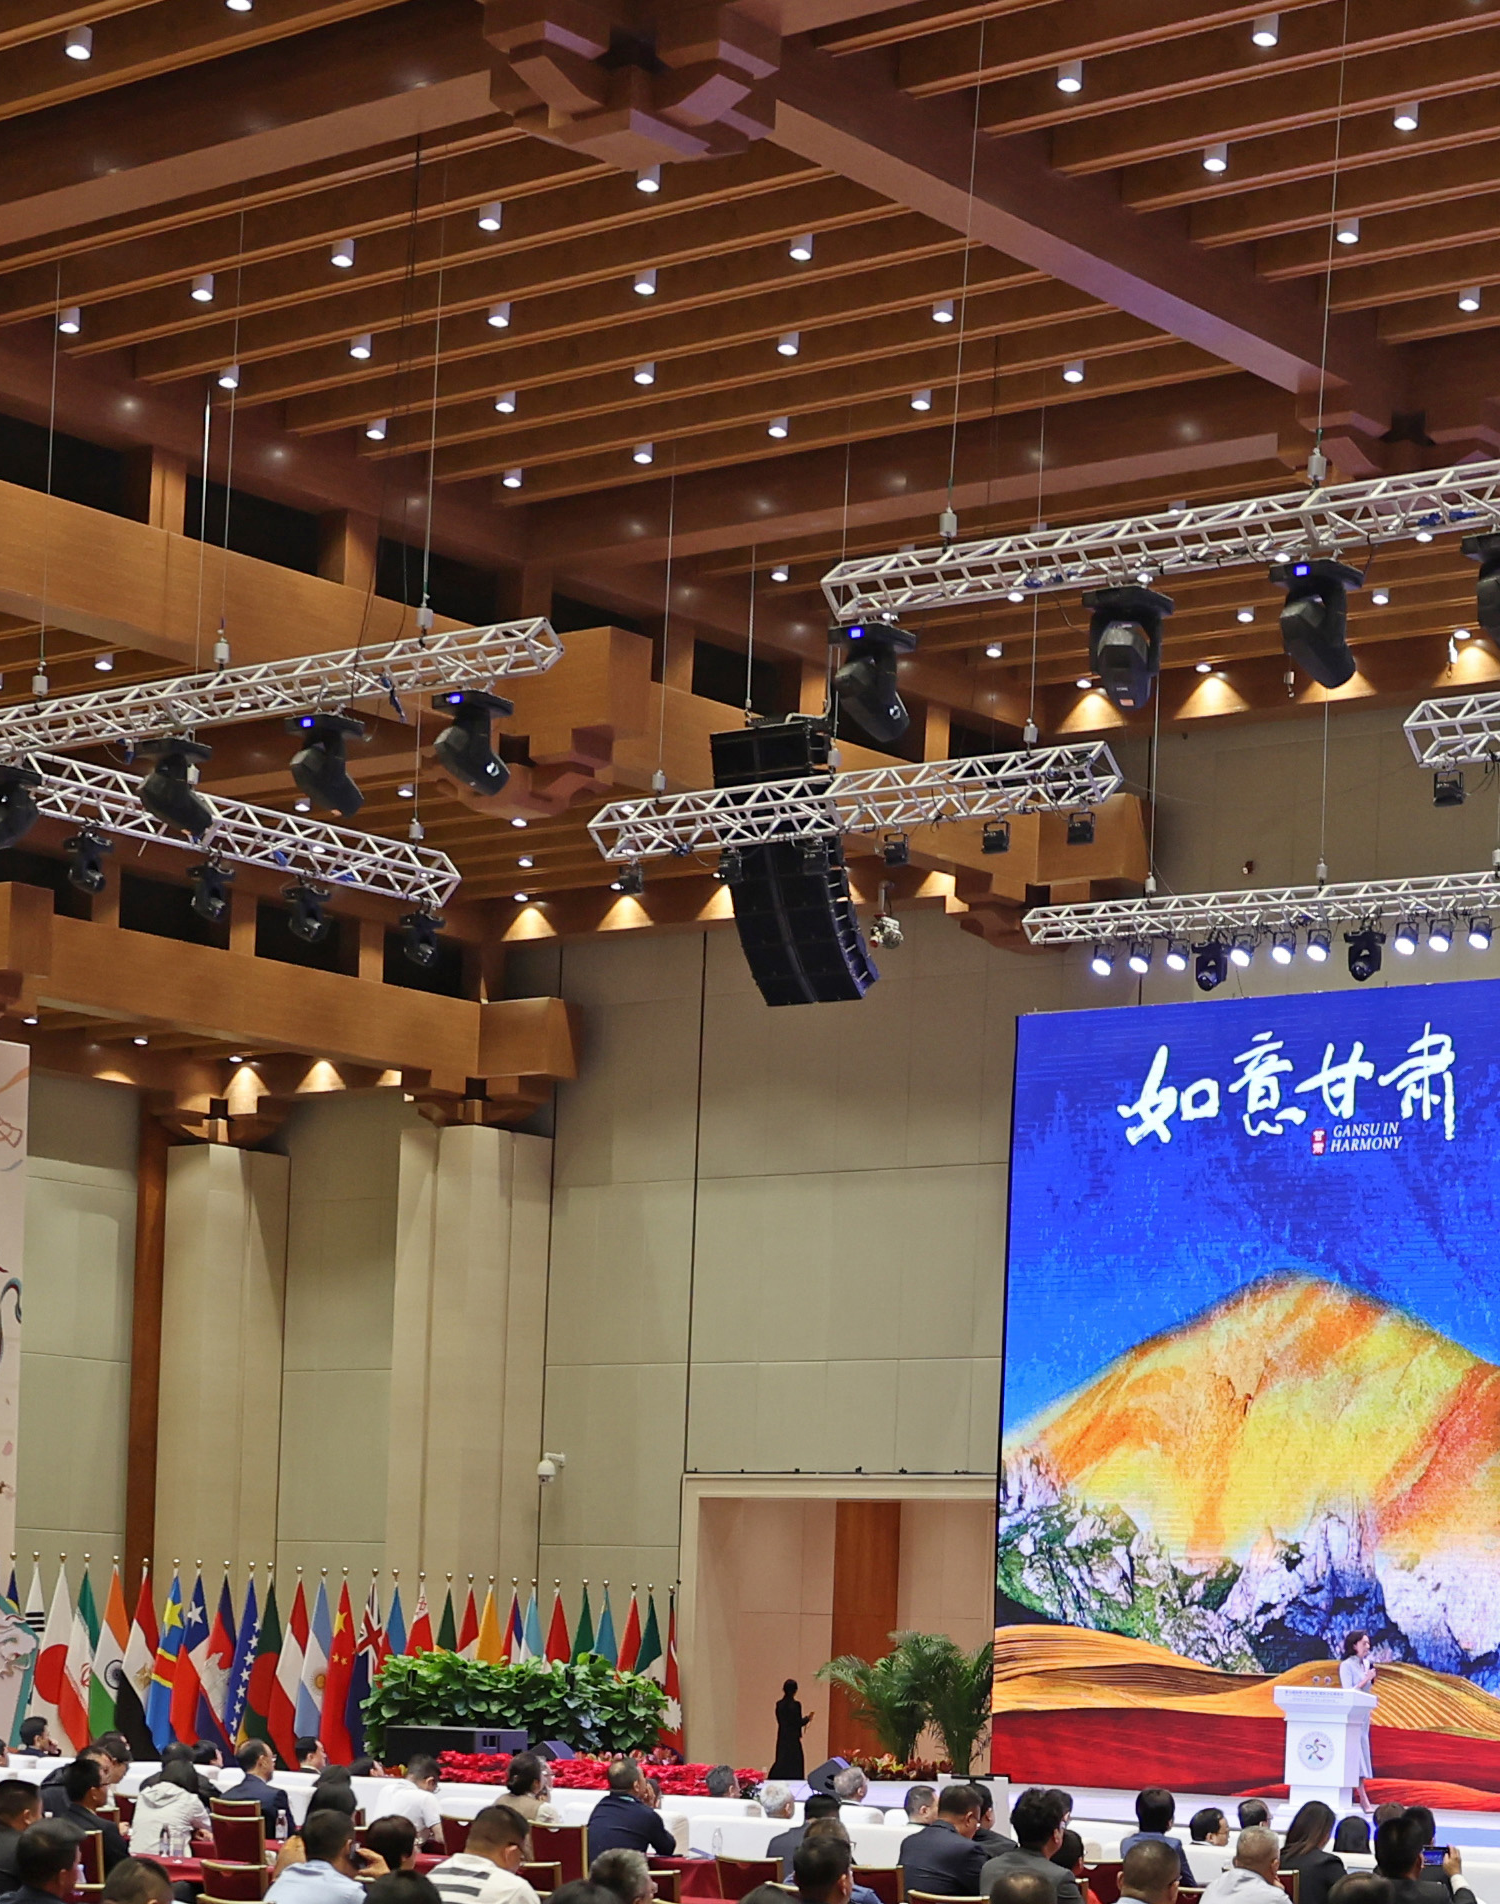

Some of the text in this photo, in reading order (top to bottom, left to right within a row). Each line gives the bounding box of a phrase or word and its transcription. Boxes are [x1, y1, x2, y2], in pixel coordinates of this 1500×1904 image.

[1116, 1021, 1457, 1145] 如意甘肃
[1333, 1121, 1400, 1138] GANSU IN
[1330, 1136, 1403, 1153] HARMONY
